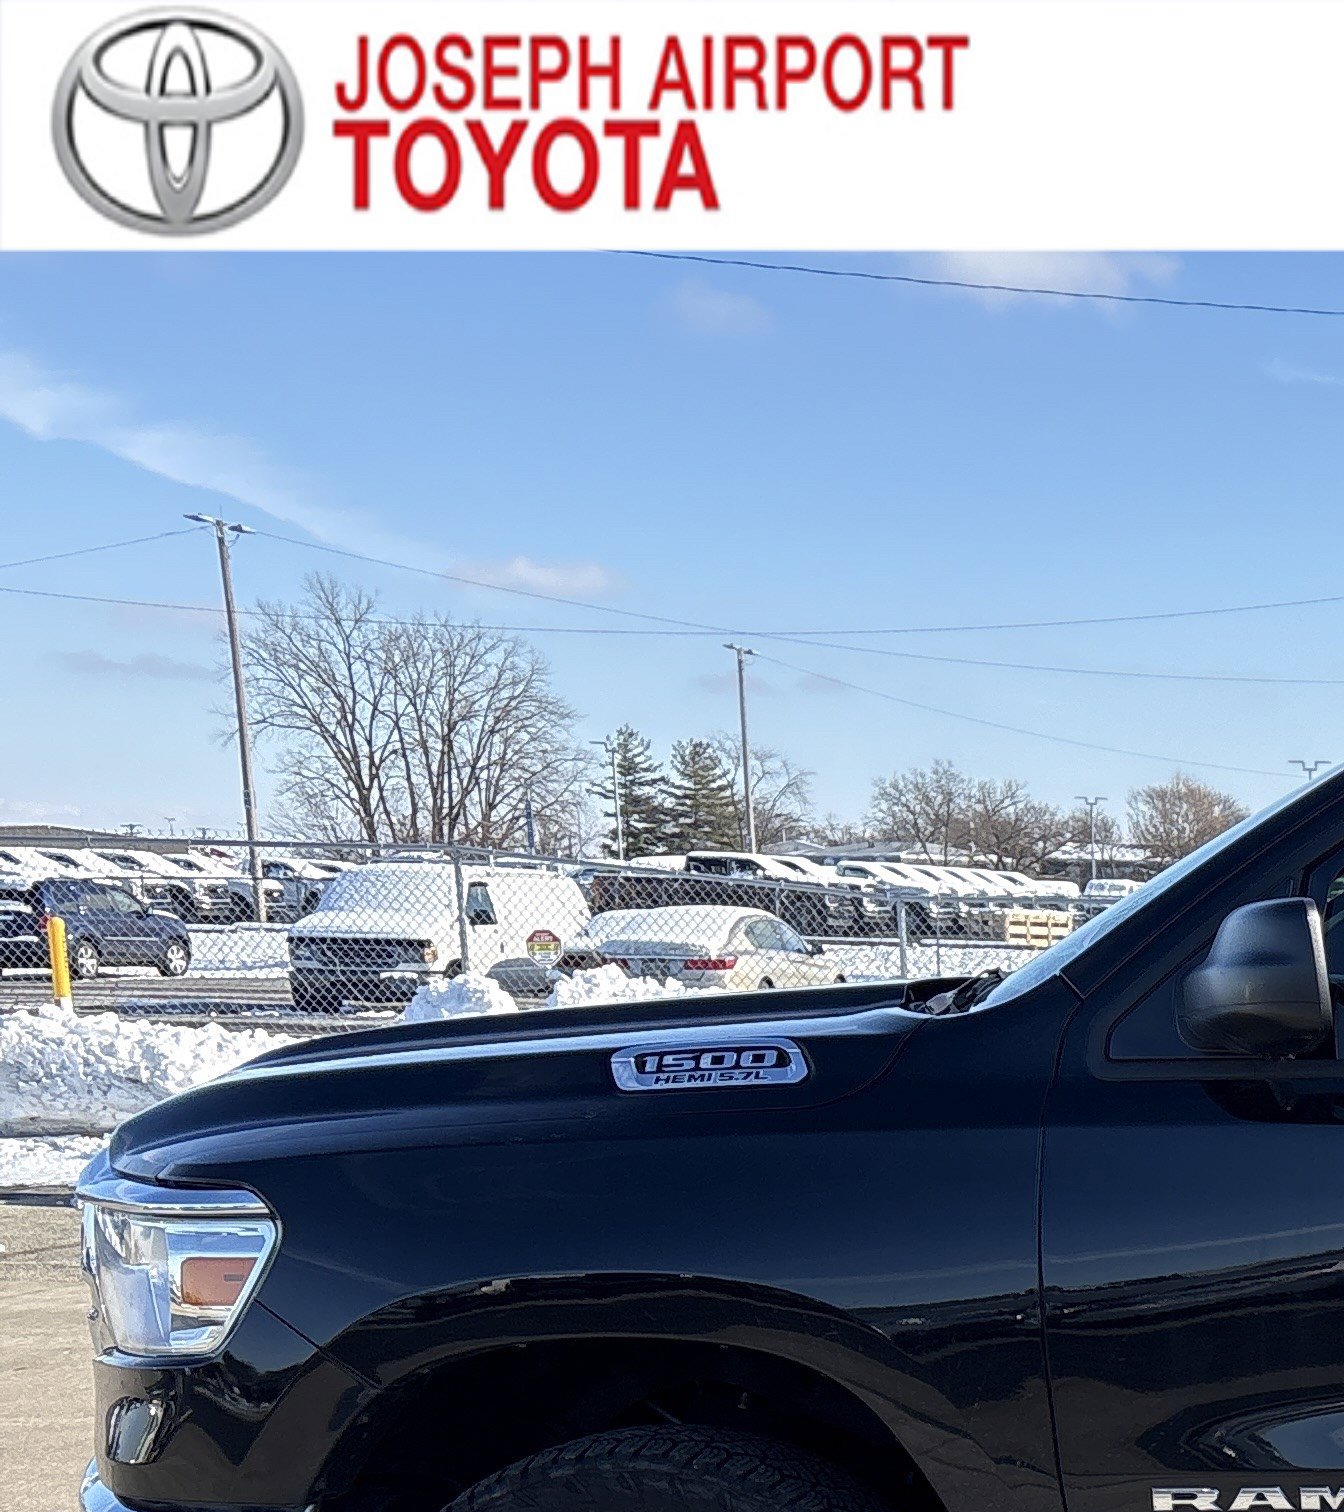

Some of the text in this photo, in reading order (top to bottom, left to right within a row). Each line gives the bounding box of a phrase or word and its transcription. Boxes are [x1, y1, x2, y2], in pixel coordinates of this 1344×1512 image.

[643, 1050, 778, 1072] 1500
[654, 1069, 768, 1085] HEMI 5.7L
